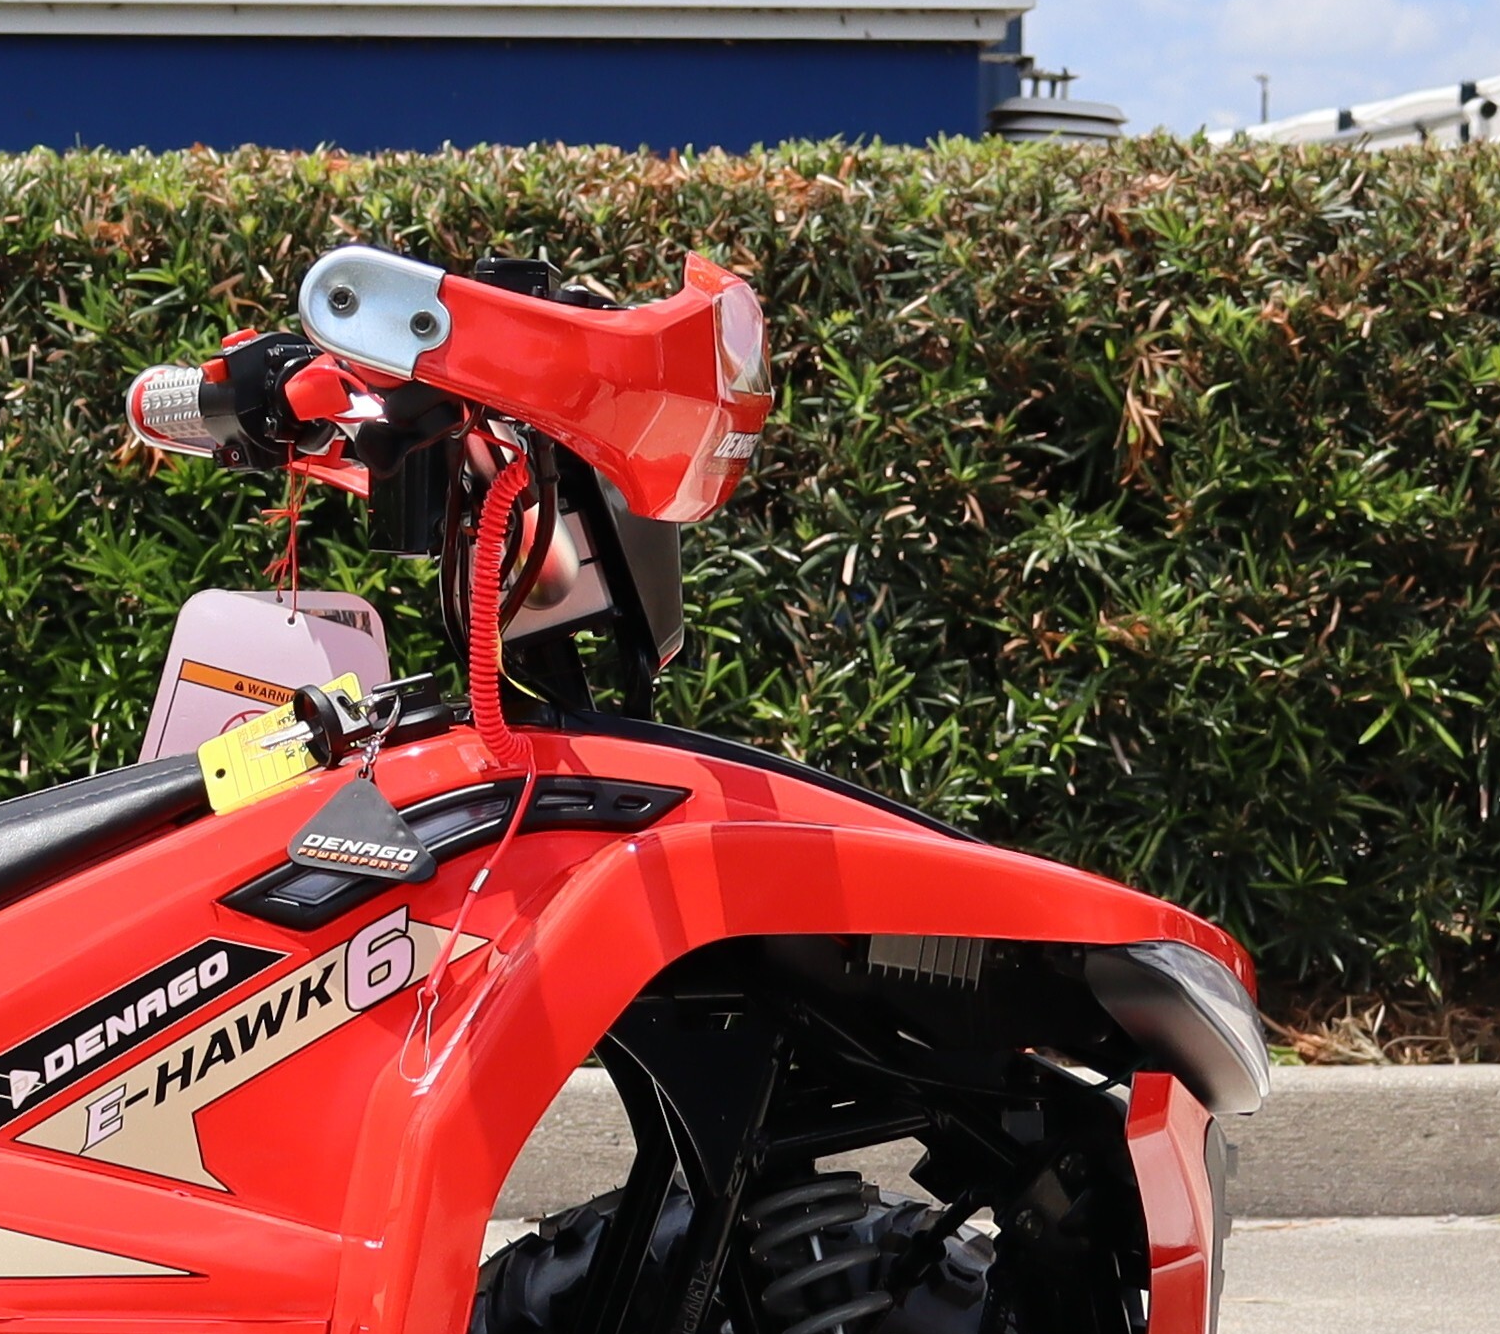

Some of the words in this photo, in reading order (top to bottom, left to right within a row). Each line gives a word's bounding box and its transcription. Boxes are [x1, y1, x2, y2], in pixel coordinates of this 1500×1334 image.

[248, 682, 297, 705] WARNI
[297, 847, 411, 873] POWERSPORTS
[302, 833, 419, 863] DENAGO
[44, 950, 230, 1085] DENAGO
[78, 960, 338, 1155] E-HAWK
[344, 904, 416, 1013] 6
